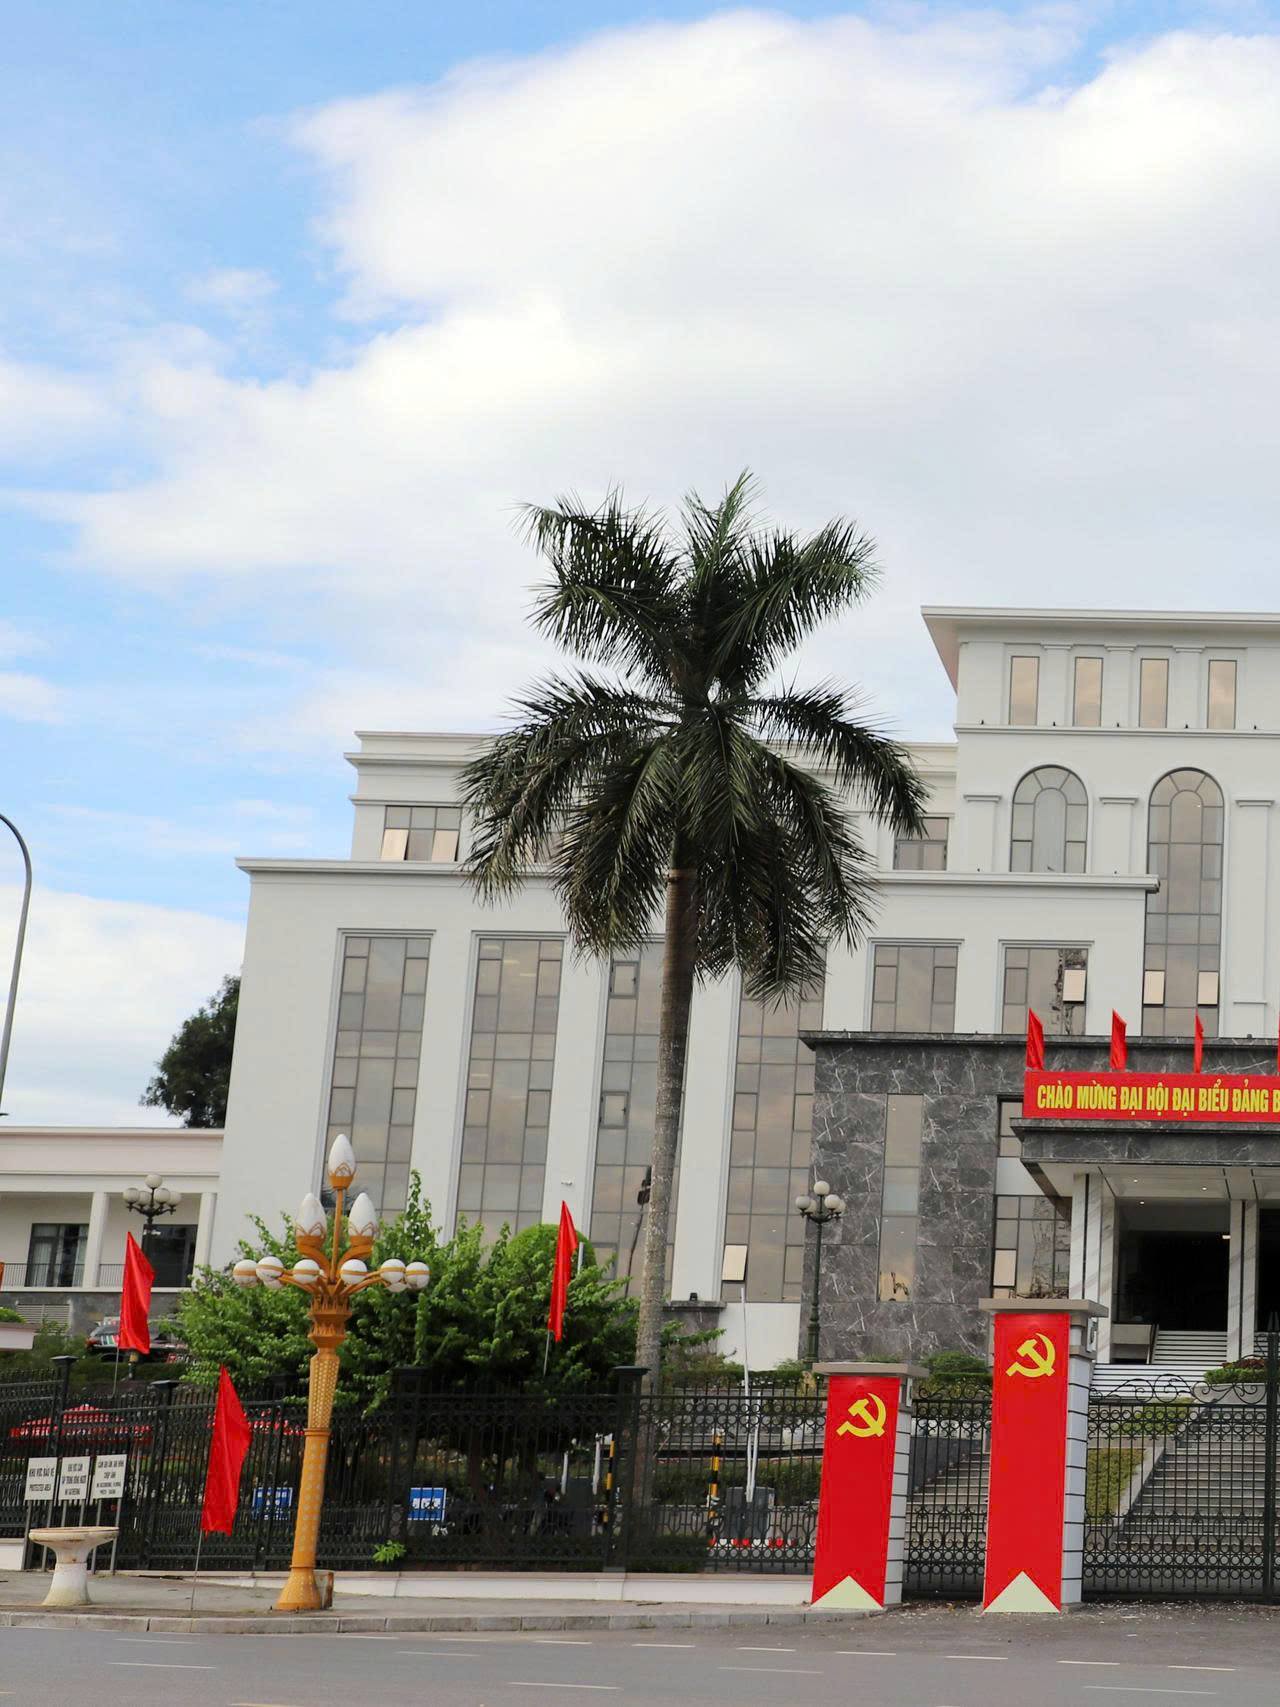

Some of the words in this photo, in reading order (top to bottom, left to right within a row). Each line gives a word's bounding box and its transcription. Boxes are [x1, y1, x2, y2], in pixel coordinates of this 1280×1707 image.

[1037, 1080, 1073, 1109] CHÀO
[1076, 1080, 1117, 1110] MỪNG
[1120, 1086, 1143, 1116] ĐẠI
[1146, 1082, 1169, 1116] HỘI
[1172, 1087, 1195, 1117] ĐẠI
[1198, 1078, 1229, 1112] BIỂU
[1232, 1079, 1269, 1113] ĐẢNG
